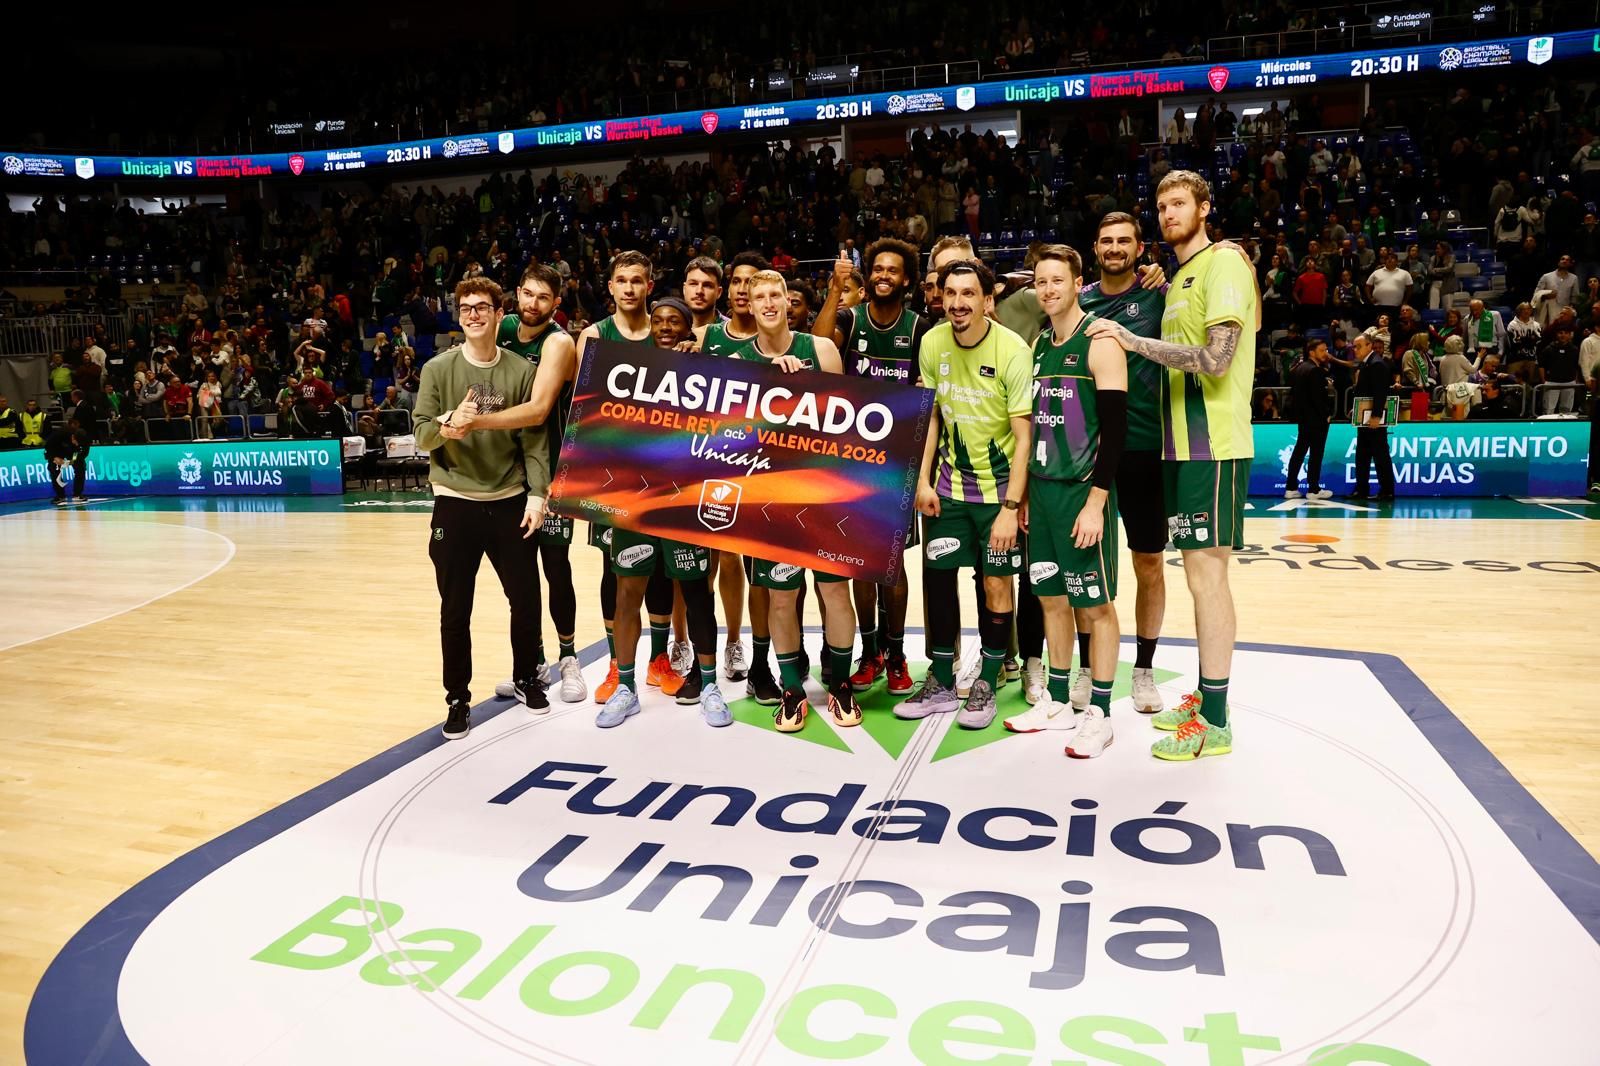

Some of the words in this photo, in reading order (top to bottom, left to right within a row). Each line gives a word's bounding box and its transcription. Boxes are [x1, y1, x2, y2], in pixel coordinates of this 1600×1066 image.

[1394, 12, 1430, 22] Fundación
[1394, 20, 1420, 28] Unicaja
[1463, 49, 1510, 59] CHAMPIONS
[1261, 60, 1311, 74] Miércoles
[1351, 56, 1402, 77] 20:30
[1407, 54, 1419, 71] H
[1090, 75, 1130, 85] Fitness
[1133, 72, 1159, 82] First
[1256, 76, 1268, 87] 21
[1272, 75, 1285, 85] de
[1287, 73, 1317, 84] enero
[1005, 83, 1059, 102] Unicaja
[1063, 79, 1085, 97] VS
[1090, 84, 1142, 97] Wurzburg
[1146, 80, 1184, 93] Basket
[744, 106, 784, 118] Miércoles
[816, 103, 858, 120] 20:30
[862, 101, 872, 116] H
[740, 120, 750, 130] 21
[753, 120, 763, 128] de
[766, 118, 789, 127] enero
[537, 128, 581, 145] Unicaja
[585, 125, 602, 140] VS
[607, 129, 649, 141] Wurzburg
[651, 125, 683, 137] Basket
[327, 150, 361, 161] Miércoles
[387, 147, 420, 163] 20:30
[423, 146, 431, 159] H
[121, 160, 171, 178] Unicaja
[174, 160, 193, 175] VS
[196, 158, 229, 167] Fitness
[324, 163, 333, 171] 21
[335, 162, 344, 170] de
[345, 161, 365, 169] enero
[197, 166, 240, 178] Wurzburg
[241, 165, 272, 176] Basket
[582, 340, 597, 386] CLASIFICADO
[870, 365, 908, 379] Unicaja
[951, 383, 993, 398] Fundación
[607, 363, 893, 441] CLASIFICADO
[600, 402, 646, 423] COPA
[651, 411, 682, 430] DEL
[687, 415, 721, 435] REY
[724, 428, 746, 440] acb
[757, 427, 841, 457] VALENCIA
[842, 446, 887, 465] 2026
[1345, 436, 1568, 458] ANTAMIENTO
[212, 450, 329, 468] AYUNTAMIENTO
[690, 433, 771, 477] Unicaja
[98, 455, 152, 487] Juega
[214, 470, 232, 485] DE
[236, 470, 282, 485] MIJAS
[1392, 462, 1475, 484] MIJAS
[900, 457, 918, 511] CLASIFICADO
[579, 499, 630, 517] 19-22/Febrero
[705, 501, 731, 511] Fundación
[708, 508, 727, 518] Unicaja
[678, 549, 695, 561] má
[817, 549, 836, 562] Roig
[837, 554, 864, 566] Arena
[885, 529, 903, 584] CLASIFICADO
[987, 553, 1008, 566] laga
[675, 559, 696, 571] laga
[1068, 574, 1082, 585] má
[1066, 582, 1085, 596] laga
[488, 760, 1347, 876] Fundación
[516, 834, 1225, 990] Unicaja
